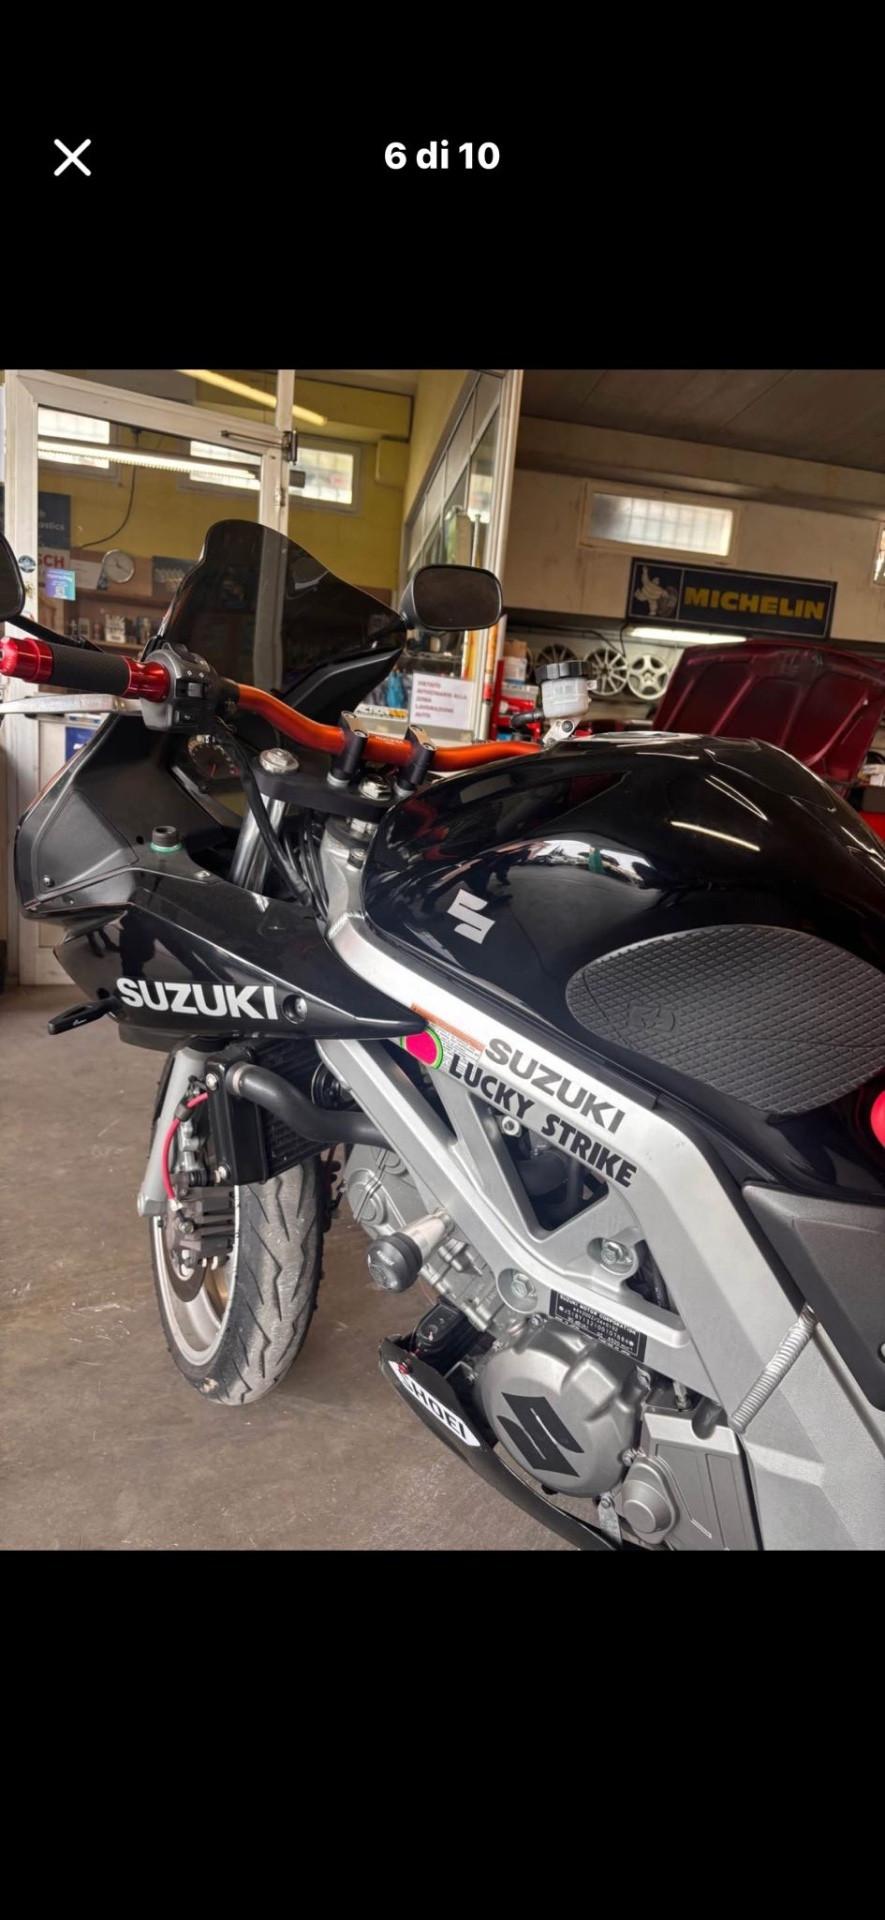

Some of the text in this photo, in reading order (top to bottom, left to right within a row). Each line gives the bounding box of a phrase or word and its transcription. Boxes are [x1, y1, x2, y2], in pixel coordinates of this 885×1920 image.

[684, 587, 825, 620] MICHELIN
[116, 977, 279, 1021] SUZUKI
[449, 1053, 638, 1189] LUCKY STRIKE
[484, 1038, 626, 1136] SUZUKI
